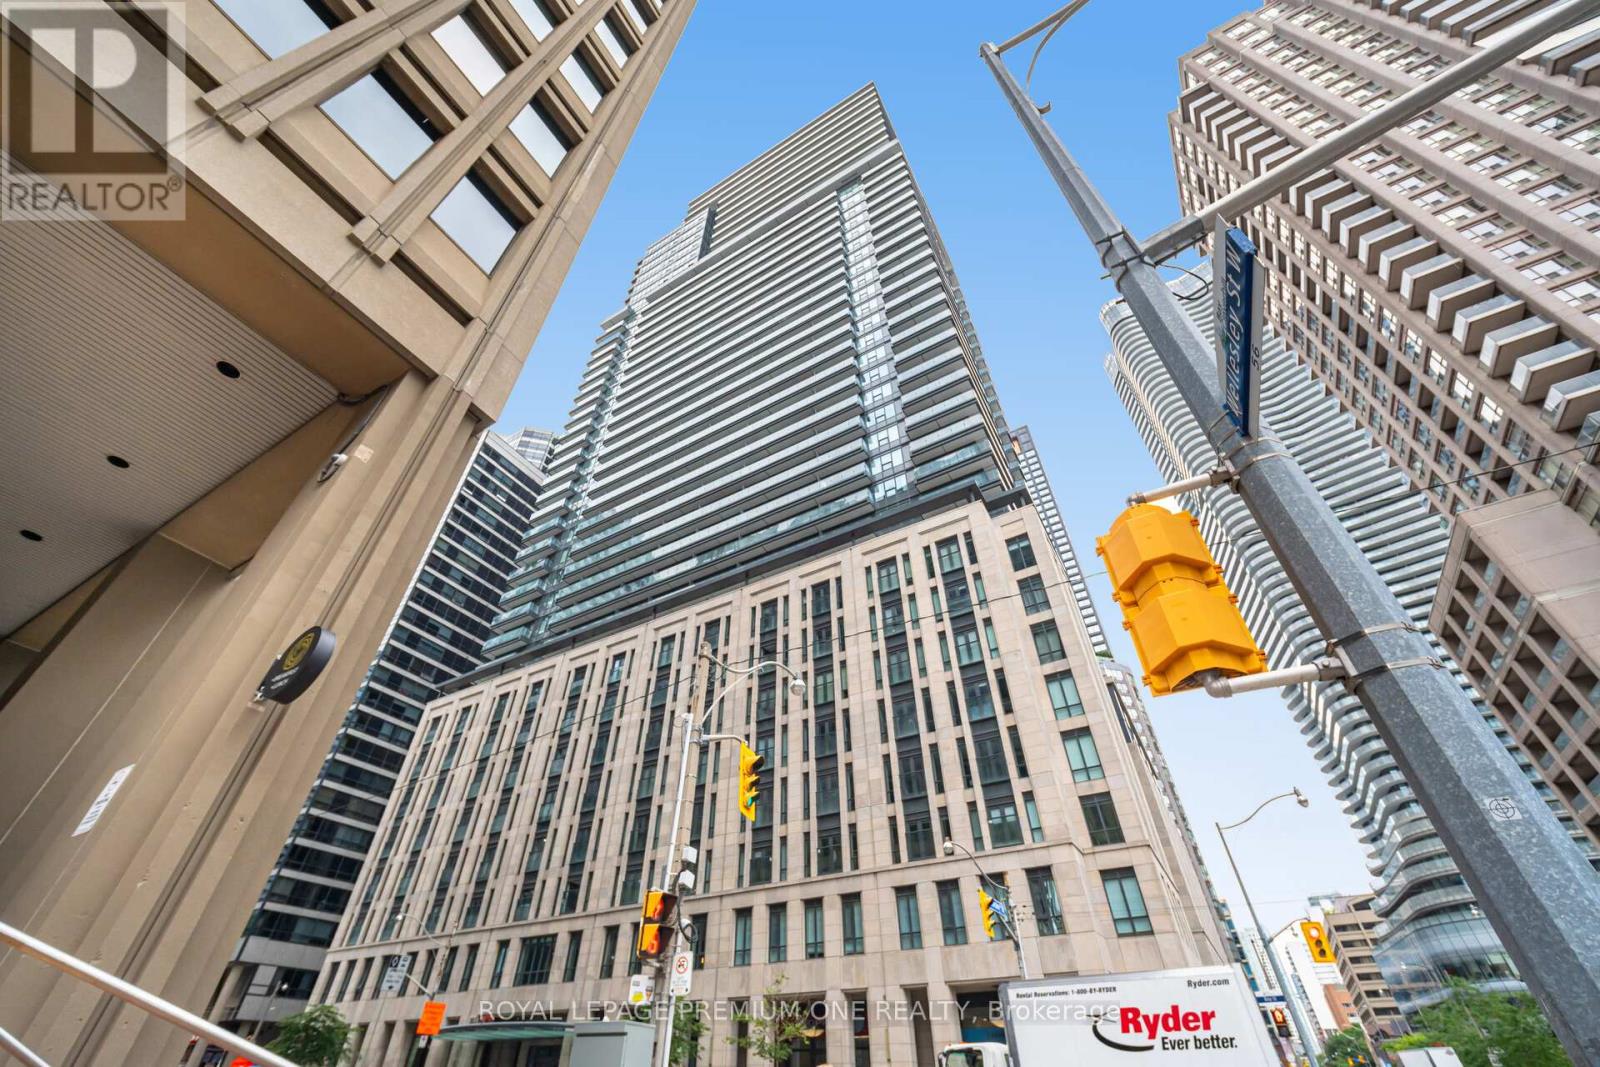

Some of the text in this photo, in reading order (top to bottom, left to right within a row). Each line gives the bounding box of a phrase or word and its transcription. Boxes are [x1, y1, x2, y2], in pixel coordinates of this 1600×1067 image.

[1225, 240, 1244, 416] Wellesley St W
[1251, 343, 1260, 371] 56
[1187, 978, 1230, 989] Ryder.com
[1120, 1005, 1216, 1040] Ryder
[1161, 1035, 1238, 1051] Ever better.
